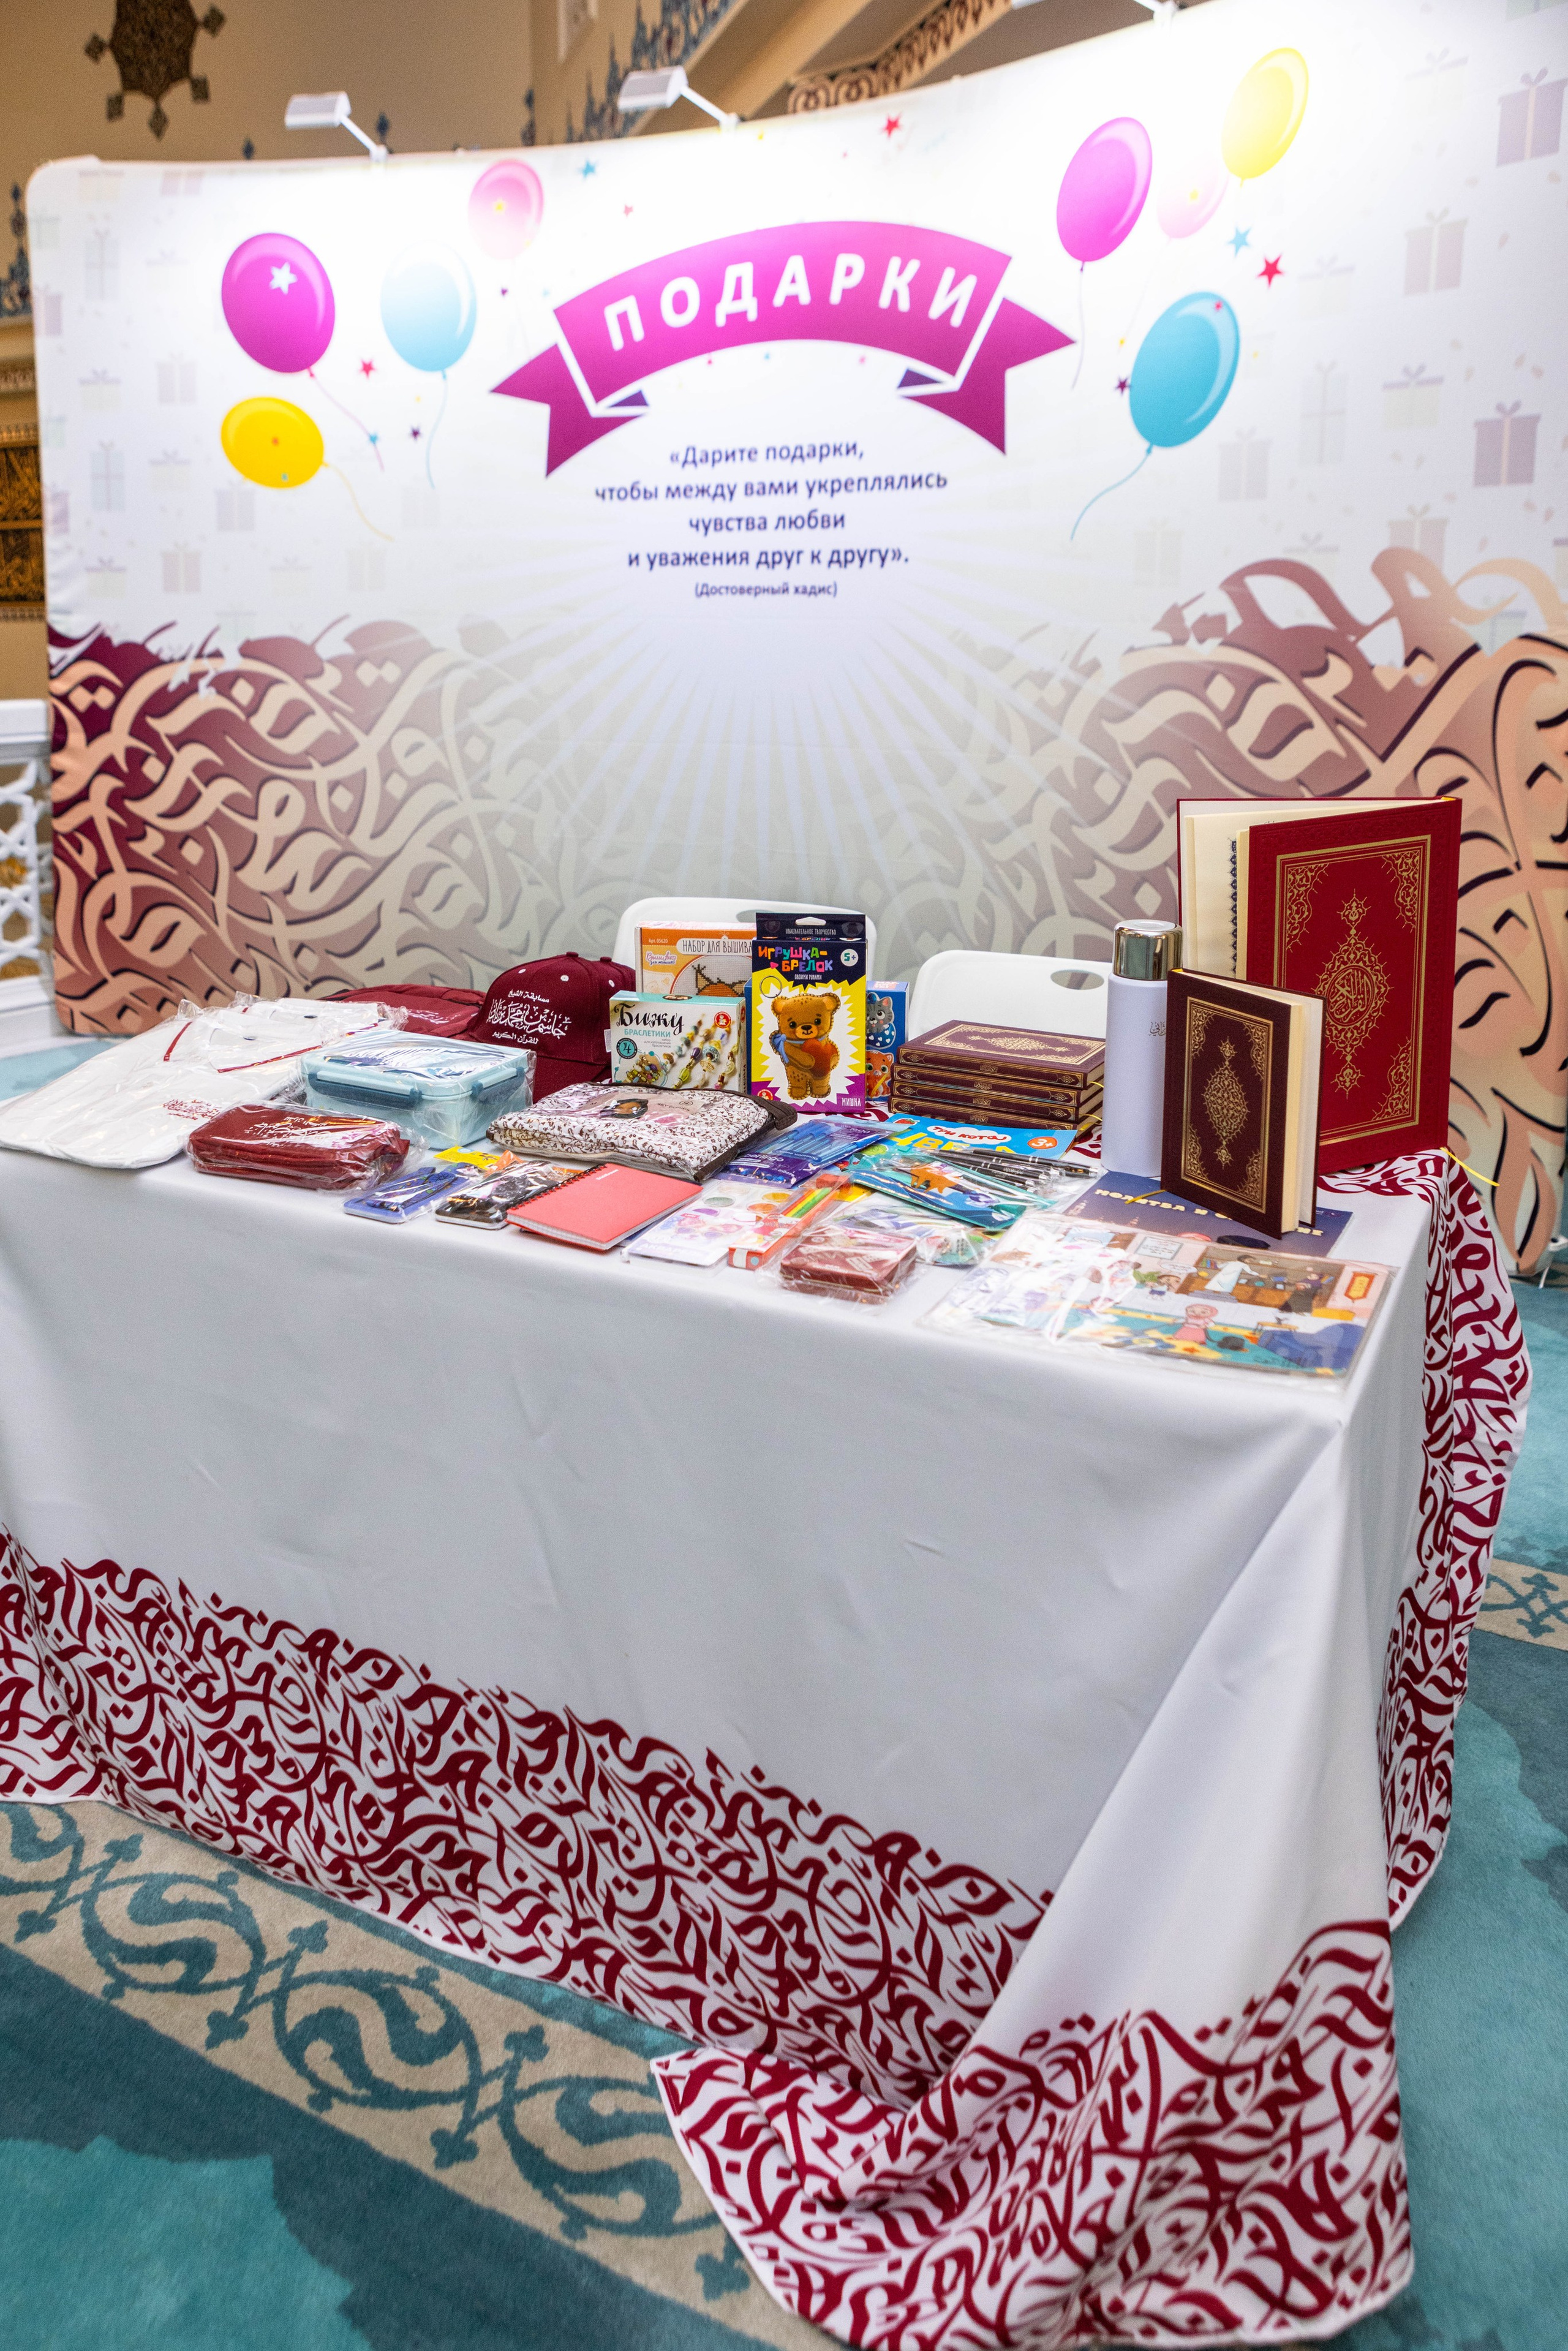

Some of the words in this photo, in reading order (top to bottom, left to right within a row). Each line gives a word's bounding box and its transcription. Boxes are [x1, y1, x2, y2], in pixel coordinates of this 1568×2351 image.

[603, 252, 978, 352] ПОДАРКИ
[669, 447, 758, 469] «Дарите
[765, 441, 864, 464] подарки,
[595, 481, 659, 502] чтобы
[665, 480, 737, 502] между
[744, 479, 798, 496] вами
[805, 471, 948, 498] укреплялись
[689, 516, 767, 537] чувства
[774, 509, 845, 530] любви
[628, 554, 639, 566] и
[646, 550, 750, 571] уважения
[756, 548, 804, 570] друг
[811, 549, 821, 565] к
[827, 547, 908, 568] другу».
[694, 583, 789, 598] (Достоверный
[794, 582, 837, 597] хадис)
[683, 940, 705, 953] НАБОР
[707, 940, 720, 954] ДЛЯ
[758, 946, 827, 960] ИГРУШКА-
[844, 953, 856, 962] 5+
[782, 959, 833, 972] БРЕЛОК
[614, 1003, 684, 1036] Бижу
[624, 1028, 671, 1038] БРАСЛЕТИКИ
[842, 1097, 861, 1107] МИШКА
[932, 1126, 957, 1136] ТРИ
[1031, 1138, 1054, 1147] 3+
